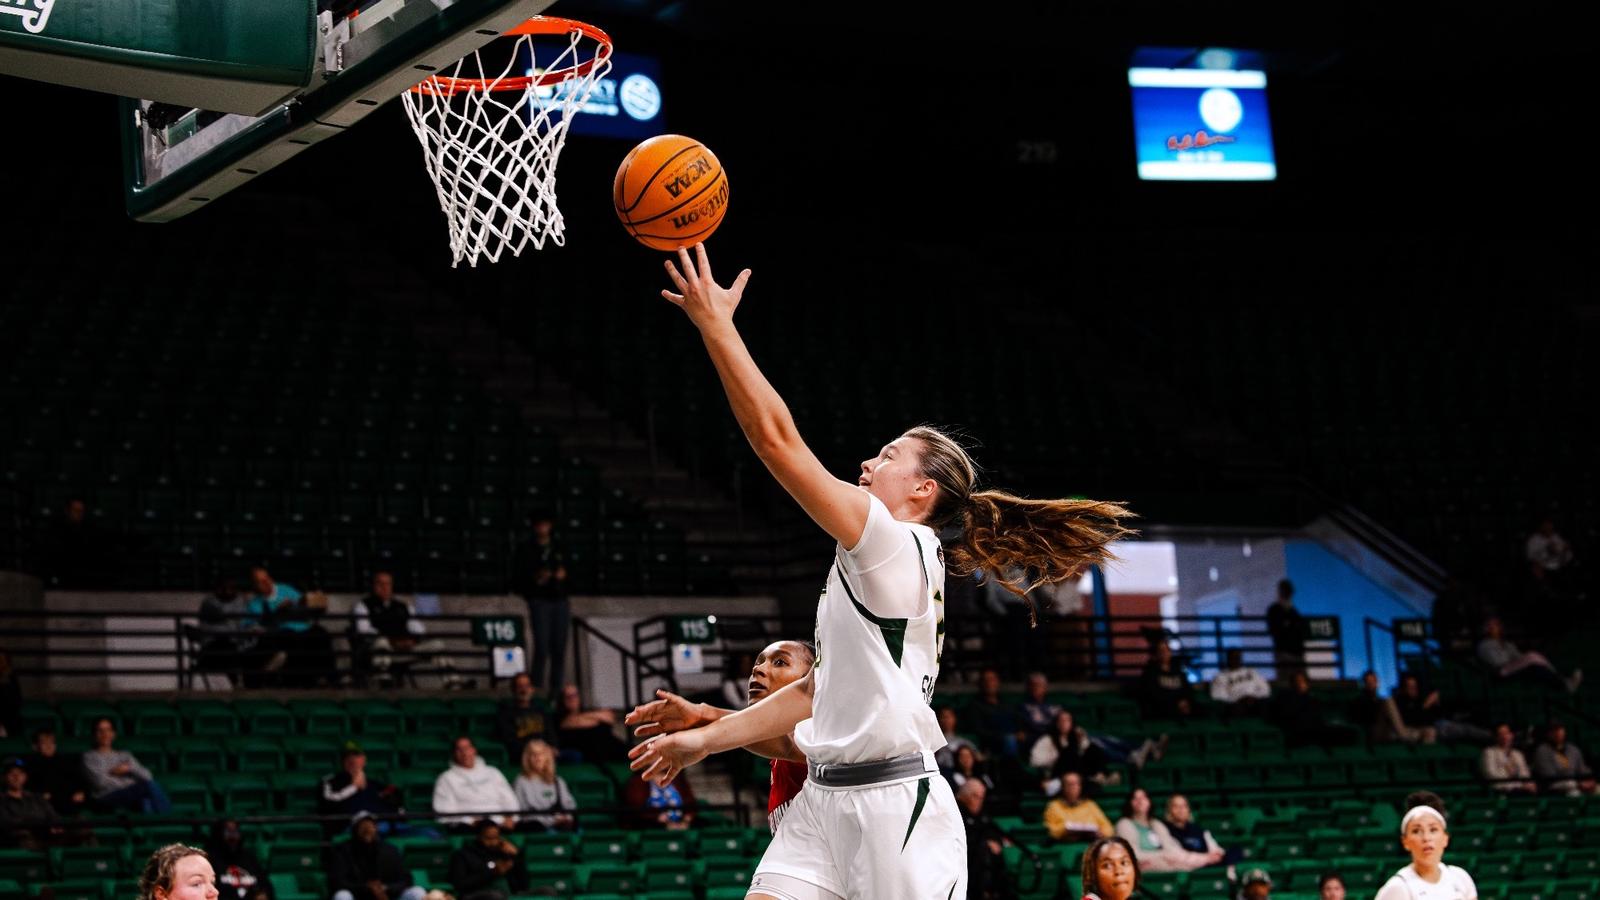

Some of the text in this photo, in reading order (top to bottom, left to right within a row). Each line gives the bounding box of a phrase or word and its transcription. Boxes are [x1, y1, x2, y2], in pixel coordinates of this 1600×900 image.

[664, 156, 712, 198] NCAA
[672, 180, 729, 229] Wilson
[484, 621, 516, 640] 116
[681, 620, 709, 639] 115
